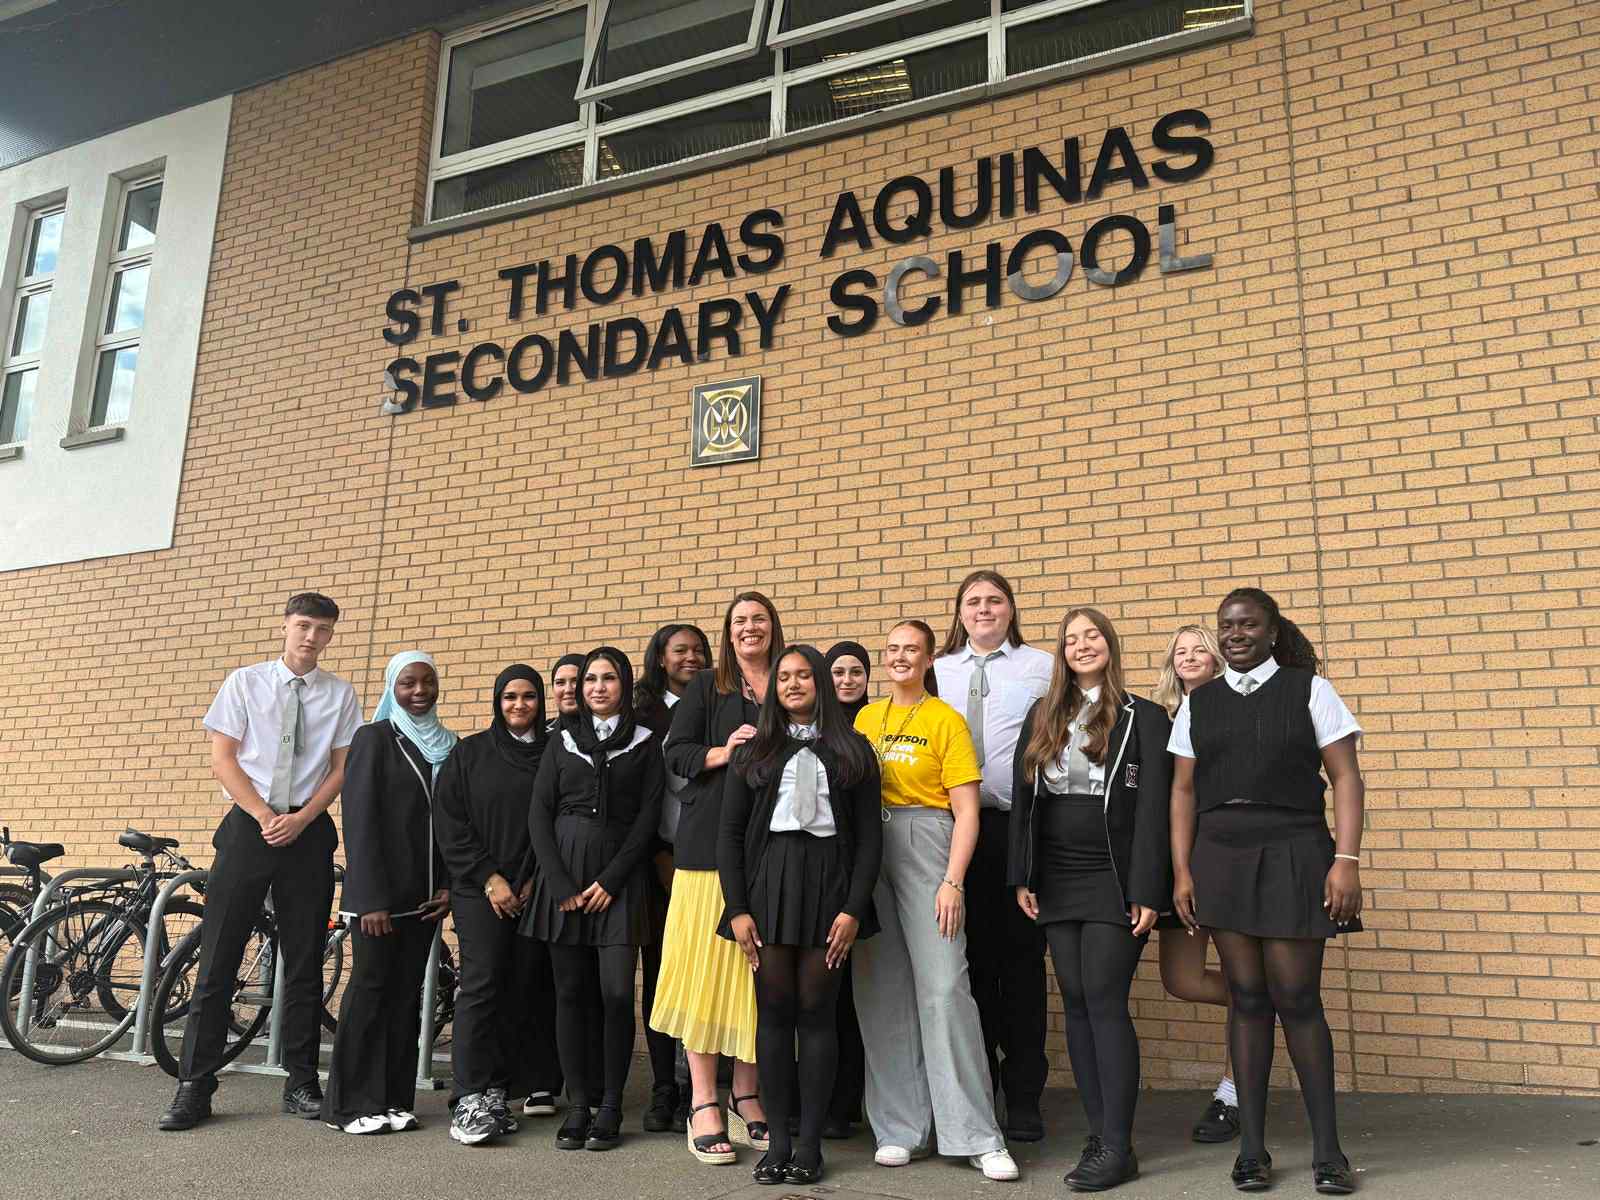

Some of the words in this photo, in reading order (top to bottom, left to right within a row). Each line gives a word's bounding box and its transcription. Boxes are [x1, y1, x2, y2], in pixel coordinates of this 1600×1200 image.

[382, 280, 469, 345] ST.
[498, 208, 786, 320] THOMAS
[819, 108, 1215, 258] AQUINAS
[382, 284, 792, 414] SECONDARY
[827, 204, 1213, 337] SCHOOL
